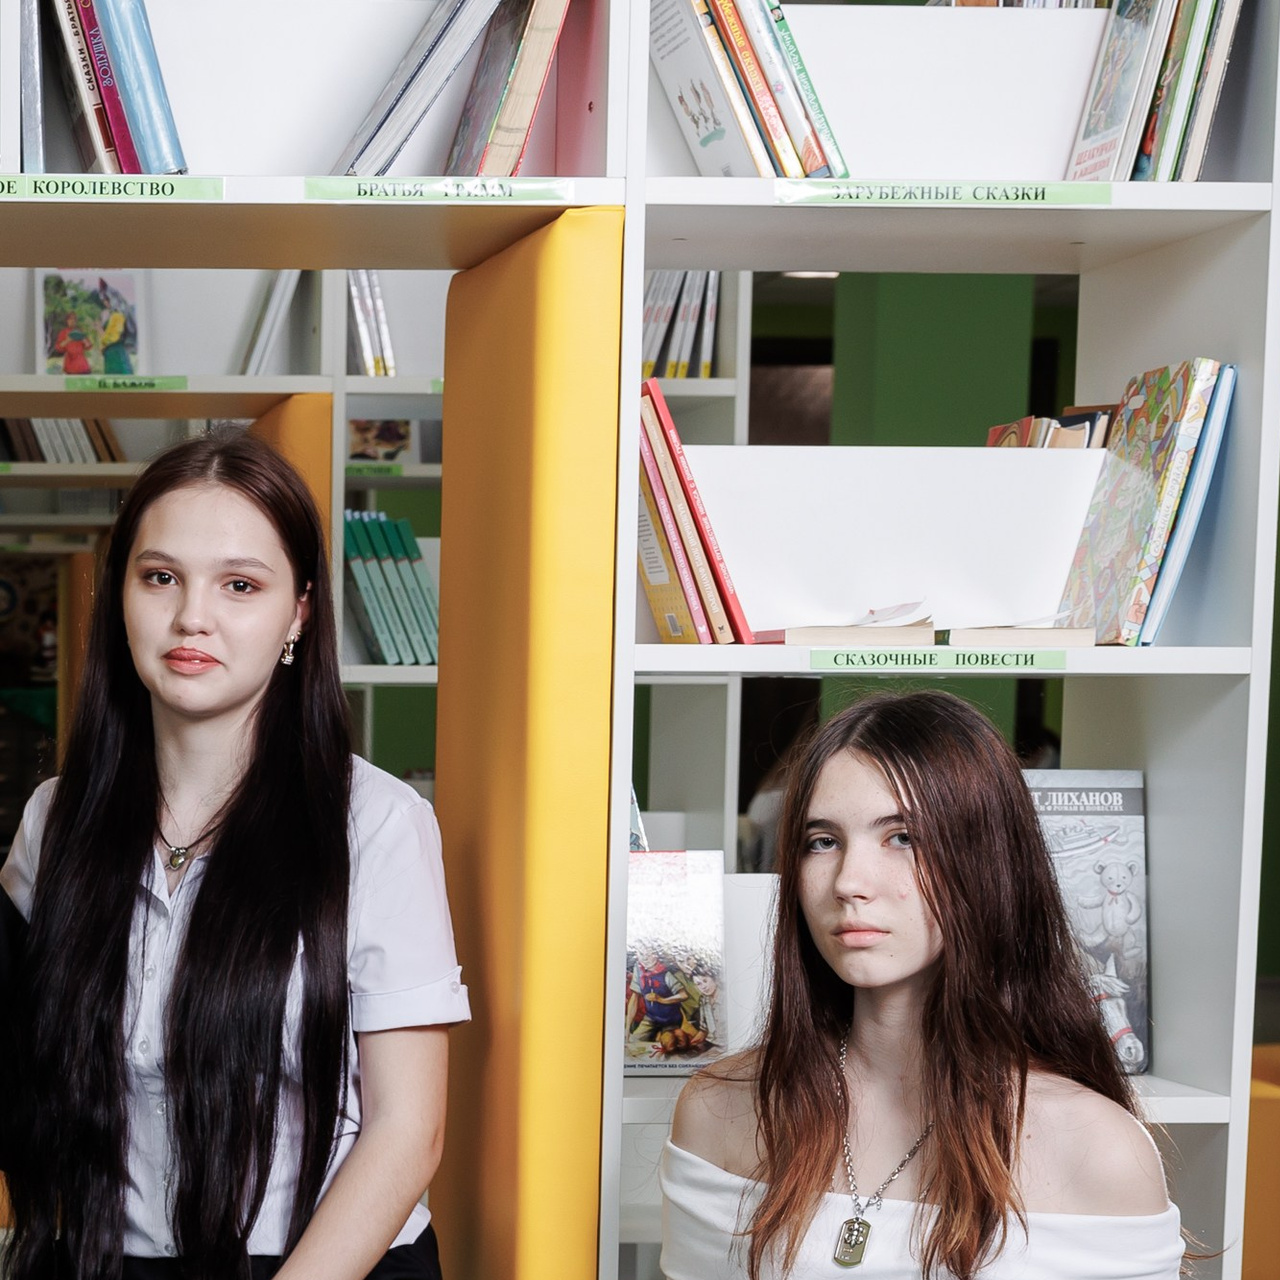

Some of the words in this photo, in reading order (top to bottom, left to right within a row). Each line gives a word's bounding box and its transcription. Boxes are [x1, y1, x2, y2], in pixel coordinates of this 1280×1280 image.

[89, 27, 114, 87] ЗОЛУШКА
[77, 48, 96, 92] СКАЗКИ
[741, 51, 764, 92] сказки
[32, 180, 175, 197] КОРОЛЕВСТВО
[357, 182, 424, 197] БРАТЬЯ
[830, 185, 962, 200] ЗАРУБЕЖНЫЕ
[972, 186, 1046, 201] СКАЗКИ
[833, 653, 939, 666] СКАЗОЧНЫЕ
[955, 653, 1035, 666] ПОВЕСТИ
[1045, 791, 1123, 806] ЛИХАНОВ
